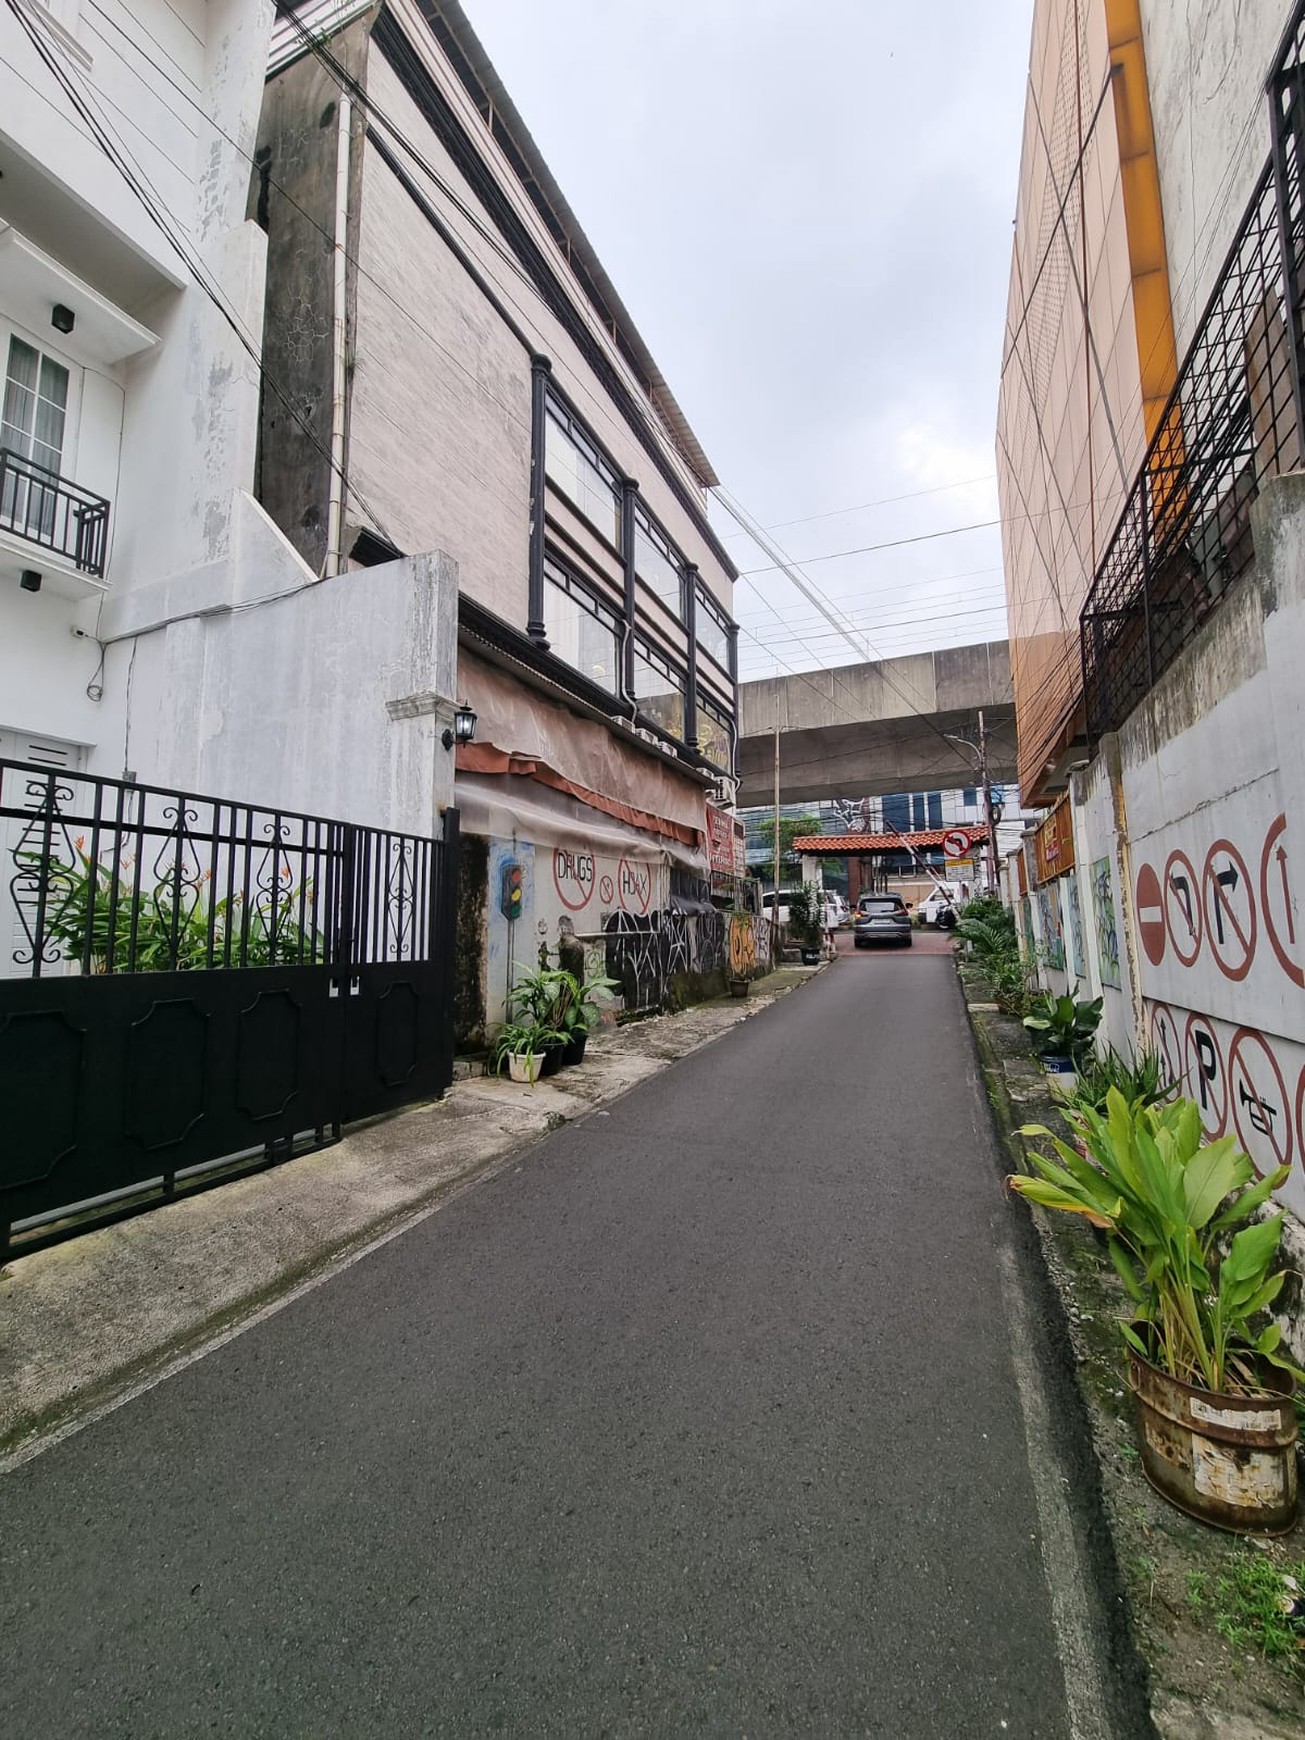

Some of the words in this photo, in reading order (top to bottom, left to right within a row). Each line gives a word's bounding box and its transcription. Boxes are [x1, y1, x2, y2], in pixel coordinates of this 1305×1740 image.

[557, 852, 592, 882] DRUGS
[622, 870, 648, 897] HOAX
[1195, 1029, 1216, 1110] P
